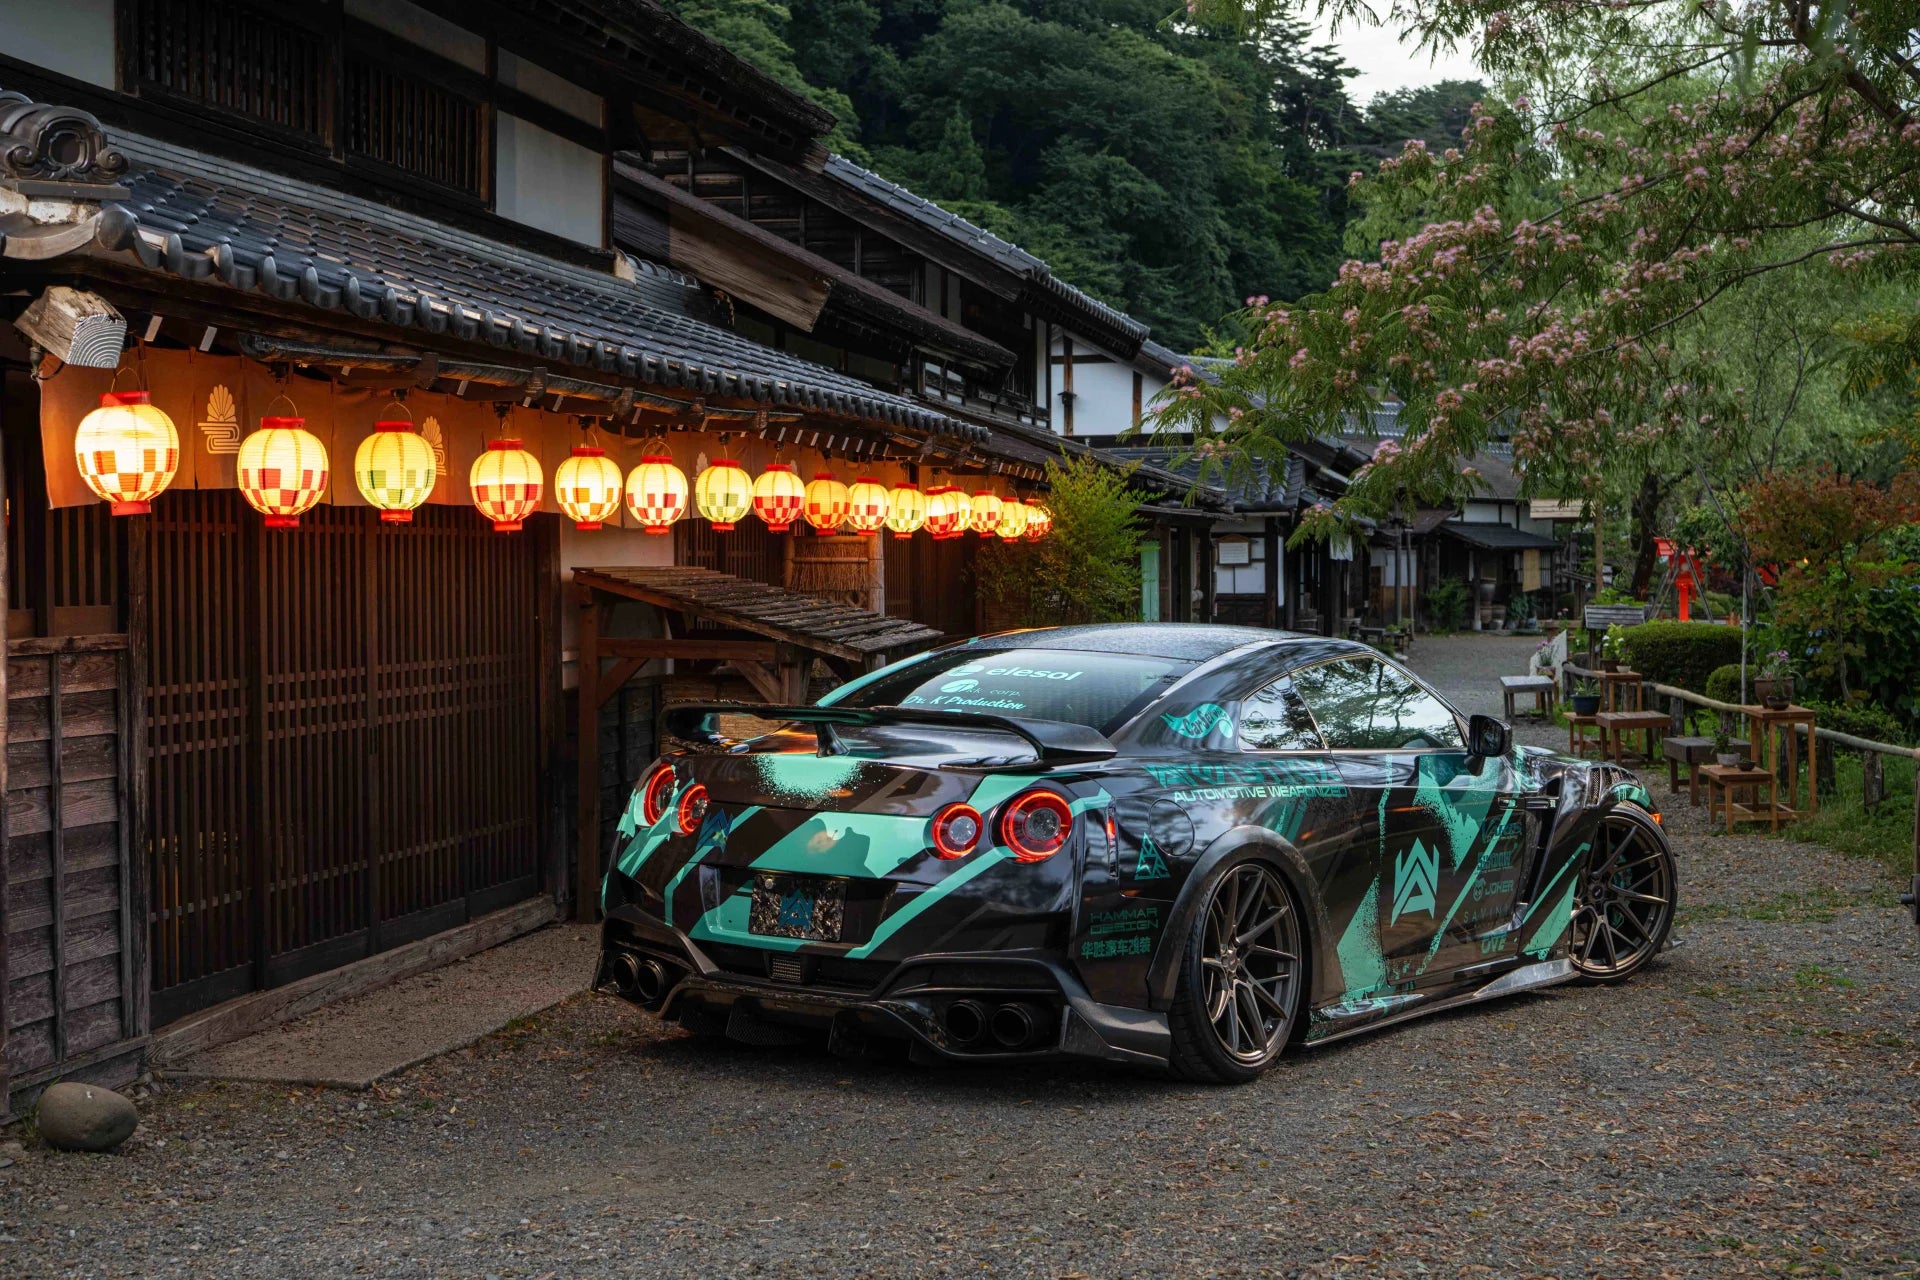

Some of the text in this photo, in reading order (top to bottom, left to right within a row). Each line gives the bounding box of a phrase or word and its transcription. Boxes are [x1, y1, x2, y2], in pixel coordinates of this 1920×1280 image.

[987, 668, 1082, 680] elesol
[944, 696, 1027, 710] Production
[1173, 785, 1348, 803] AUTOMOTIVE WEAPONIZED
[1090, 908, 1158, 922] HAMMAR
[1090, 920, 1158, 934] DESIGN
